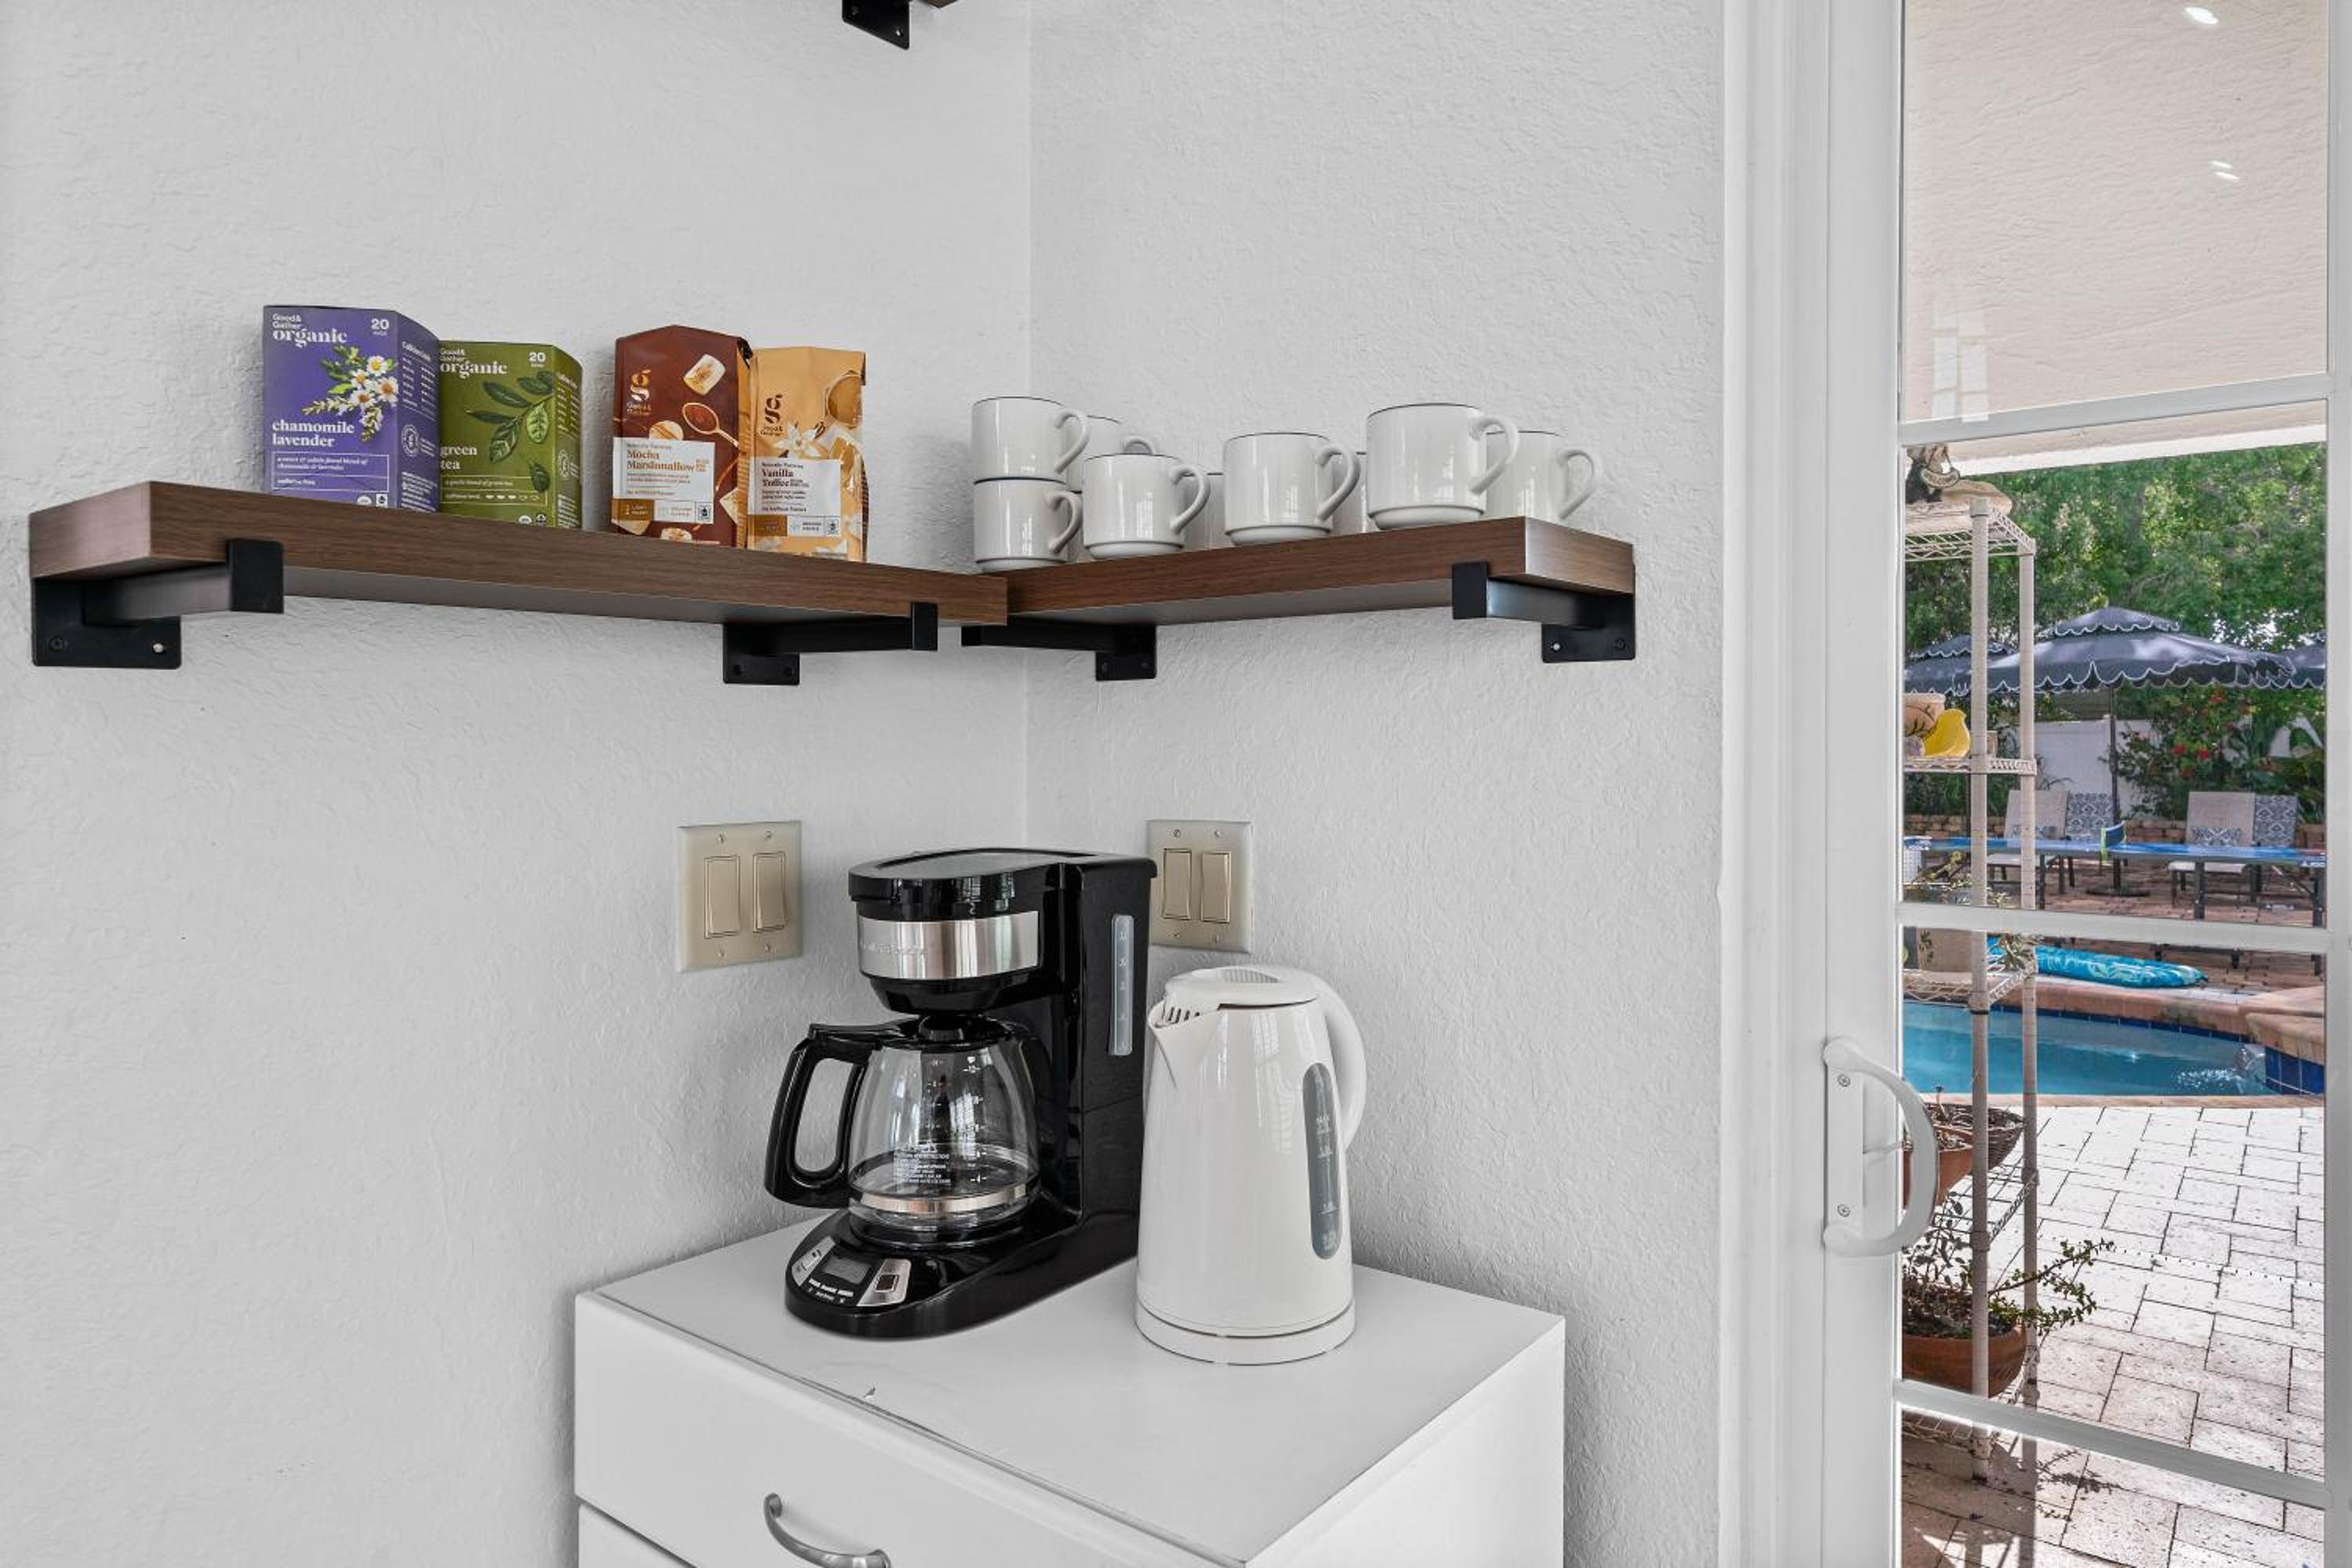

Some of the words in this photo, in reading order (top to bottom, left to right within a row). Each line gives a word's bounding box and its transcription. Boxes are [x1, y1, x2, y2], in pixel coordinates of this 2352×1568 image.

[371, 318, 390, 330] 20
[272, 328, 347, 348] organic
[529, 352, 546, 362] 20
[440, 360, 507, 379] organic
[272, 419, 354, 434] chamomile
[272, 432, 335, 447] lavender
[441, 446, 477, 456] green
[627, 451, 659, 460] Mocha
[440, 459, 461, 470] tea
[627, 460, 695, 472] Marshmallow
[762, 469, 794, 477] Vanilla
[763, 478, 789, 487] Toffee
